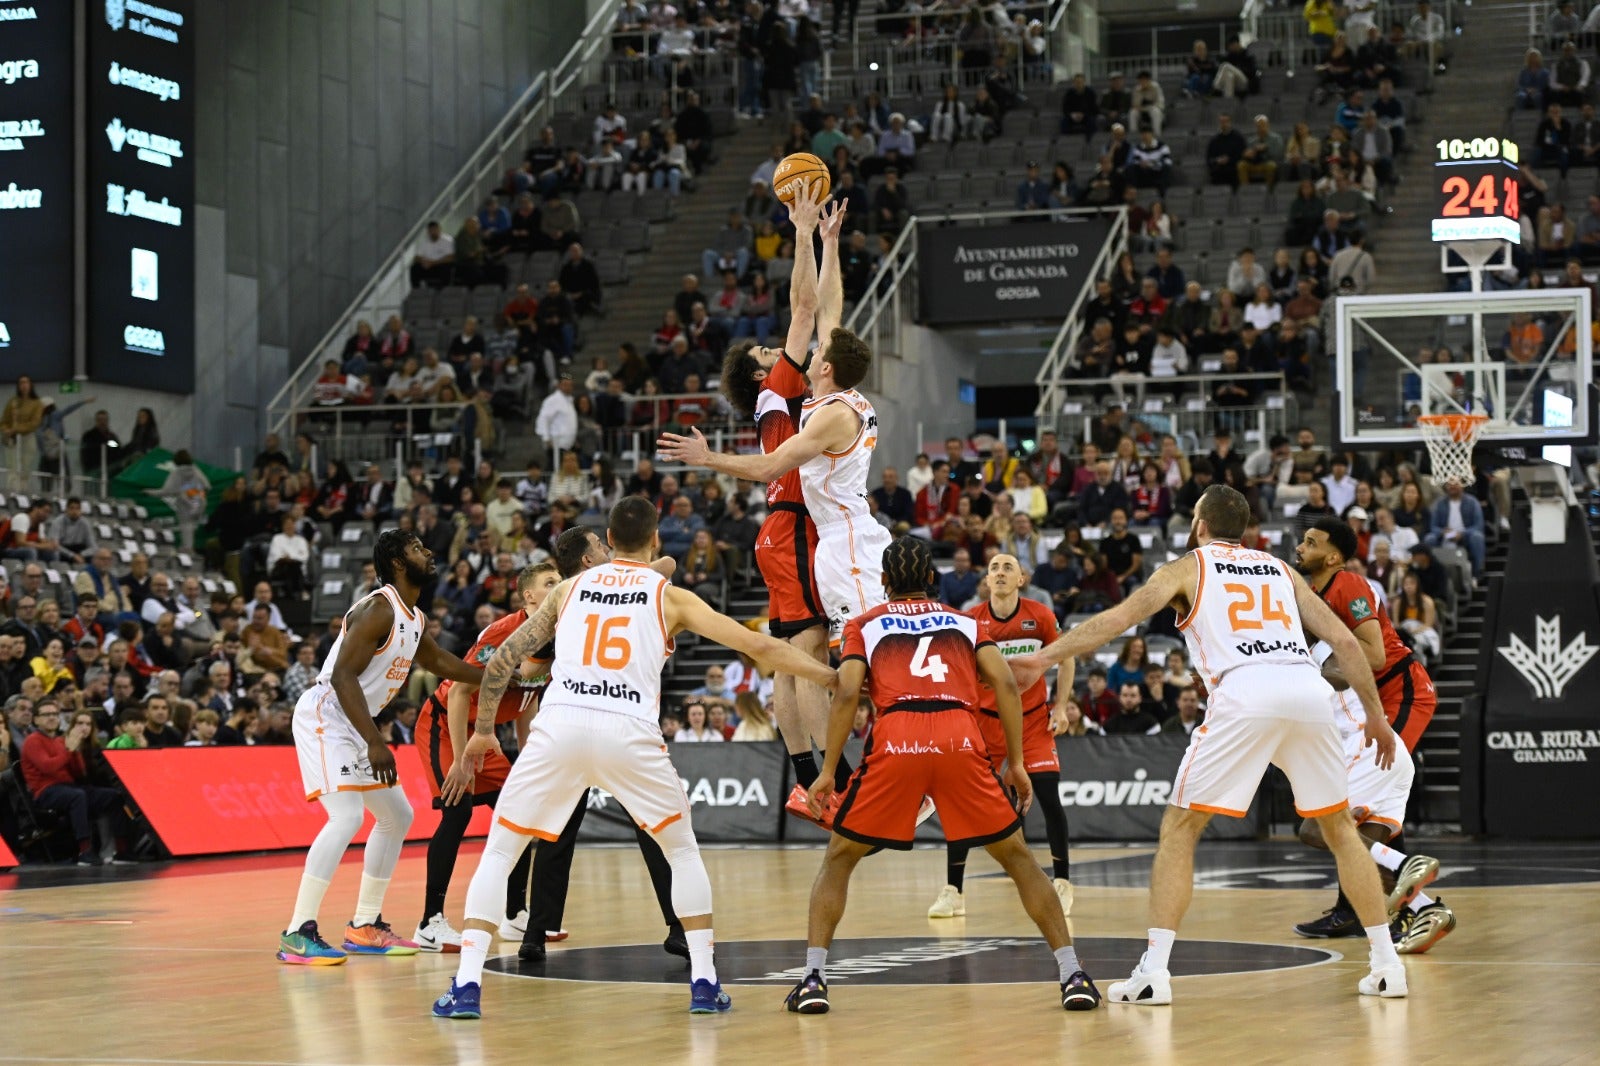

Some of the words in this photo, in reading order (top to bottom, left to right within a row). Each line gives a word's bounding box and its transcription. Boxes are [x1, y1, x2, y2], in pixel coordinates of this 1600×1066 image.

[0, 59, 39, 84] gra
[1436, 137, 1500, 160] 10:00
[1442, 174, 1499, 217] 24
[954, 243, 1079, 264] AYUNTAMIENTO
[964, 268, 985, 283] DE
[989, 262, 1068, 281] GRANADA
[1214, 562, 1281, 577] PAMESA
[580, 589, 648, 606] PAMESA
[1223, 583, 1293, 632] 24
[886, 602, 943, 615] GRIFFIN
[880, 615, 959, 632] PULEVA
[582, 613, 632, 671] 16
[909, 635, 949, 683] 4
[885, 739, 944, 755] Andalucía
[1487, 731, 1538, 750] CAJA
[1541, 730, 1600, 749] RURA
[1513, 749, 1588, 764] GRANADA
[1058, 768, 1170, 807] COVIR
